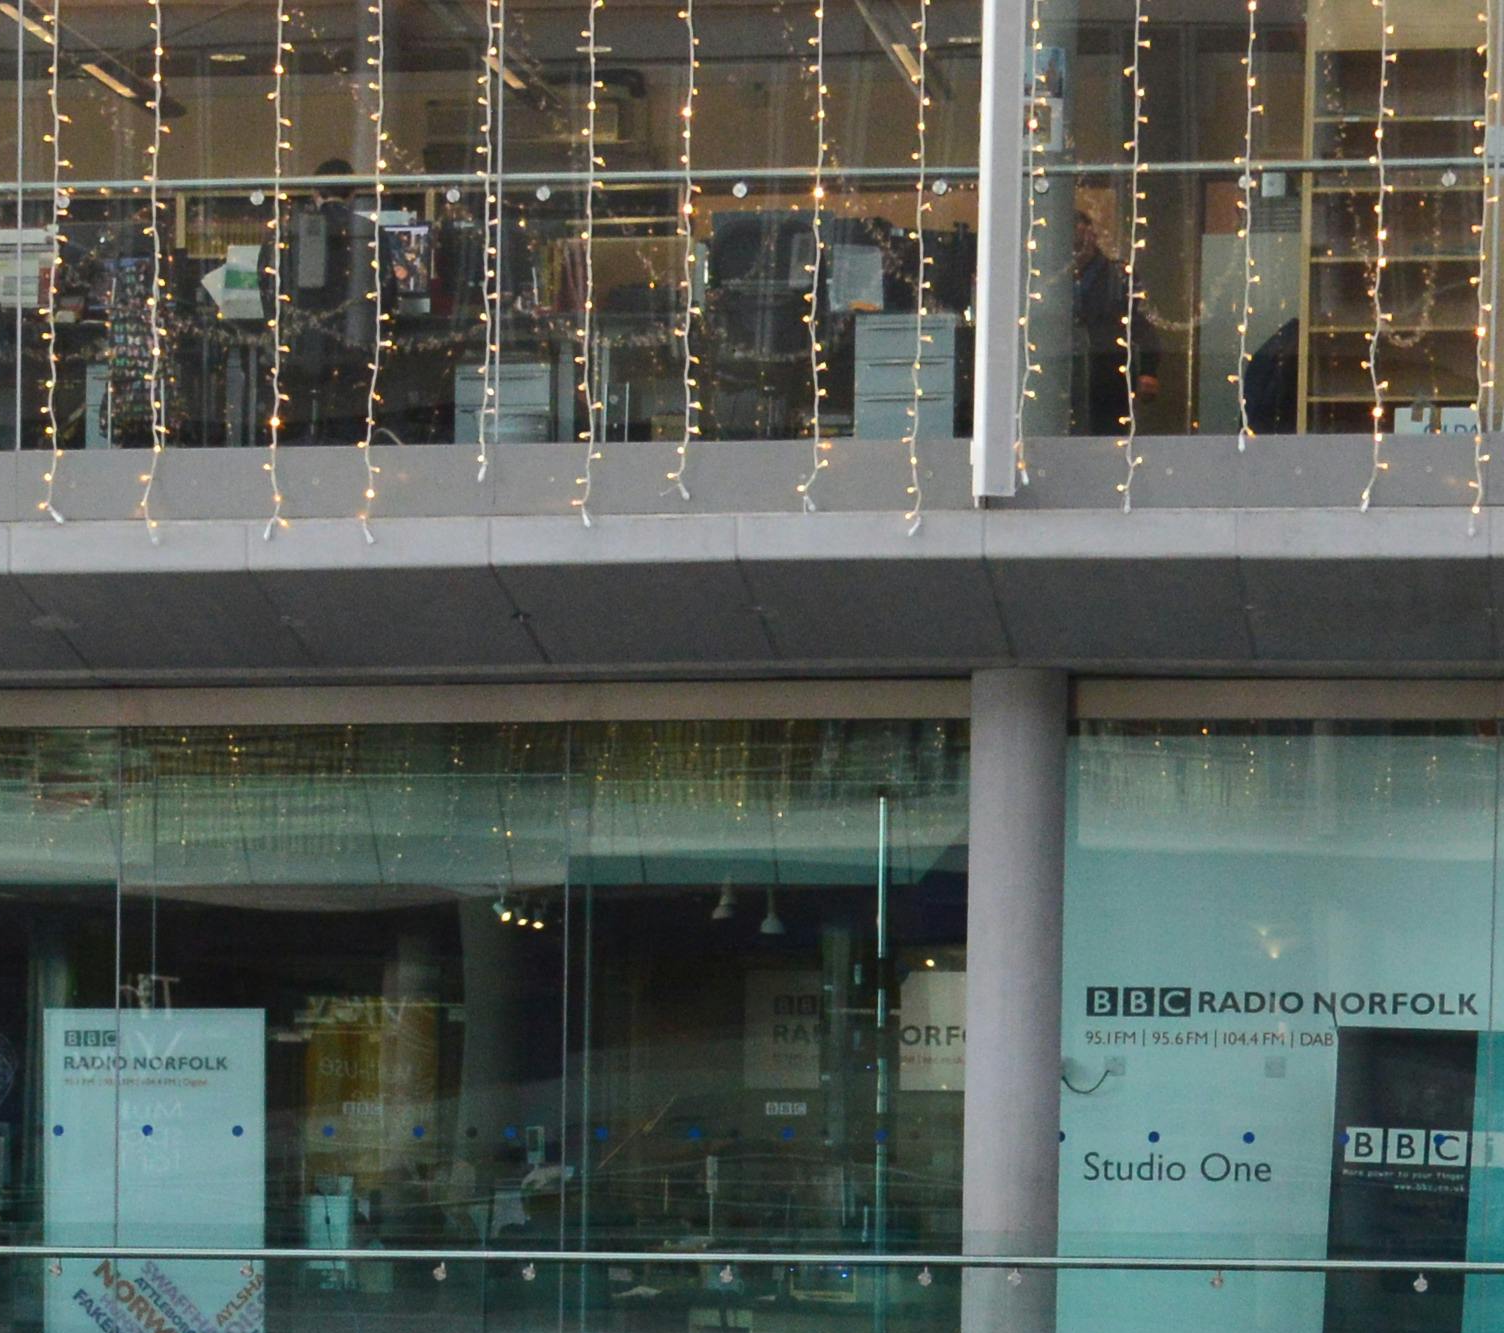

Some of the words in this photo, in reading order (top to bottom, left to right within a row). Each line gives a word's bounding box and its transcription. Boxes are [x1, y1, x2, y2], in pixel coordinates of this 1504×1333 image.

[1086, 986, 1191, 1017] BBC
[1198, 991, 1304, 1014] RADIO
[1312, 992, 1478, 1016] NORFOLK
[64, 1030, 118, 1047] BBC
[1301, 1032, 1334, 1047] DAB
[64, 1056, 127, 1070] RADIO
[134, 1056, 228, 1071] NORFOLK
[1348, 1129, 1464, 1164] BBC
[1083, 1152, 1186, 1183] Studio
[1201, 1153, 1272, 1183] One
[1366, 1169, 1395, 1180] power
